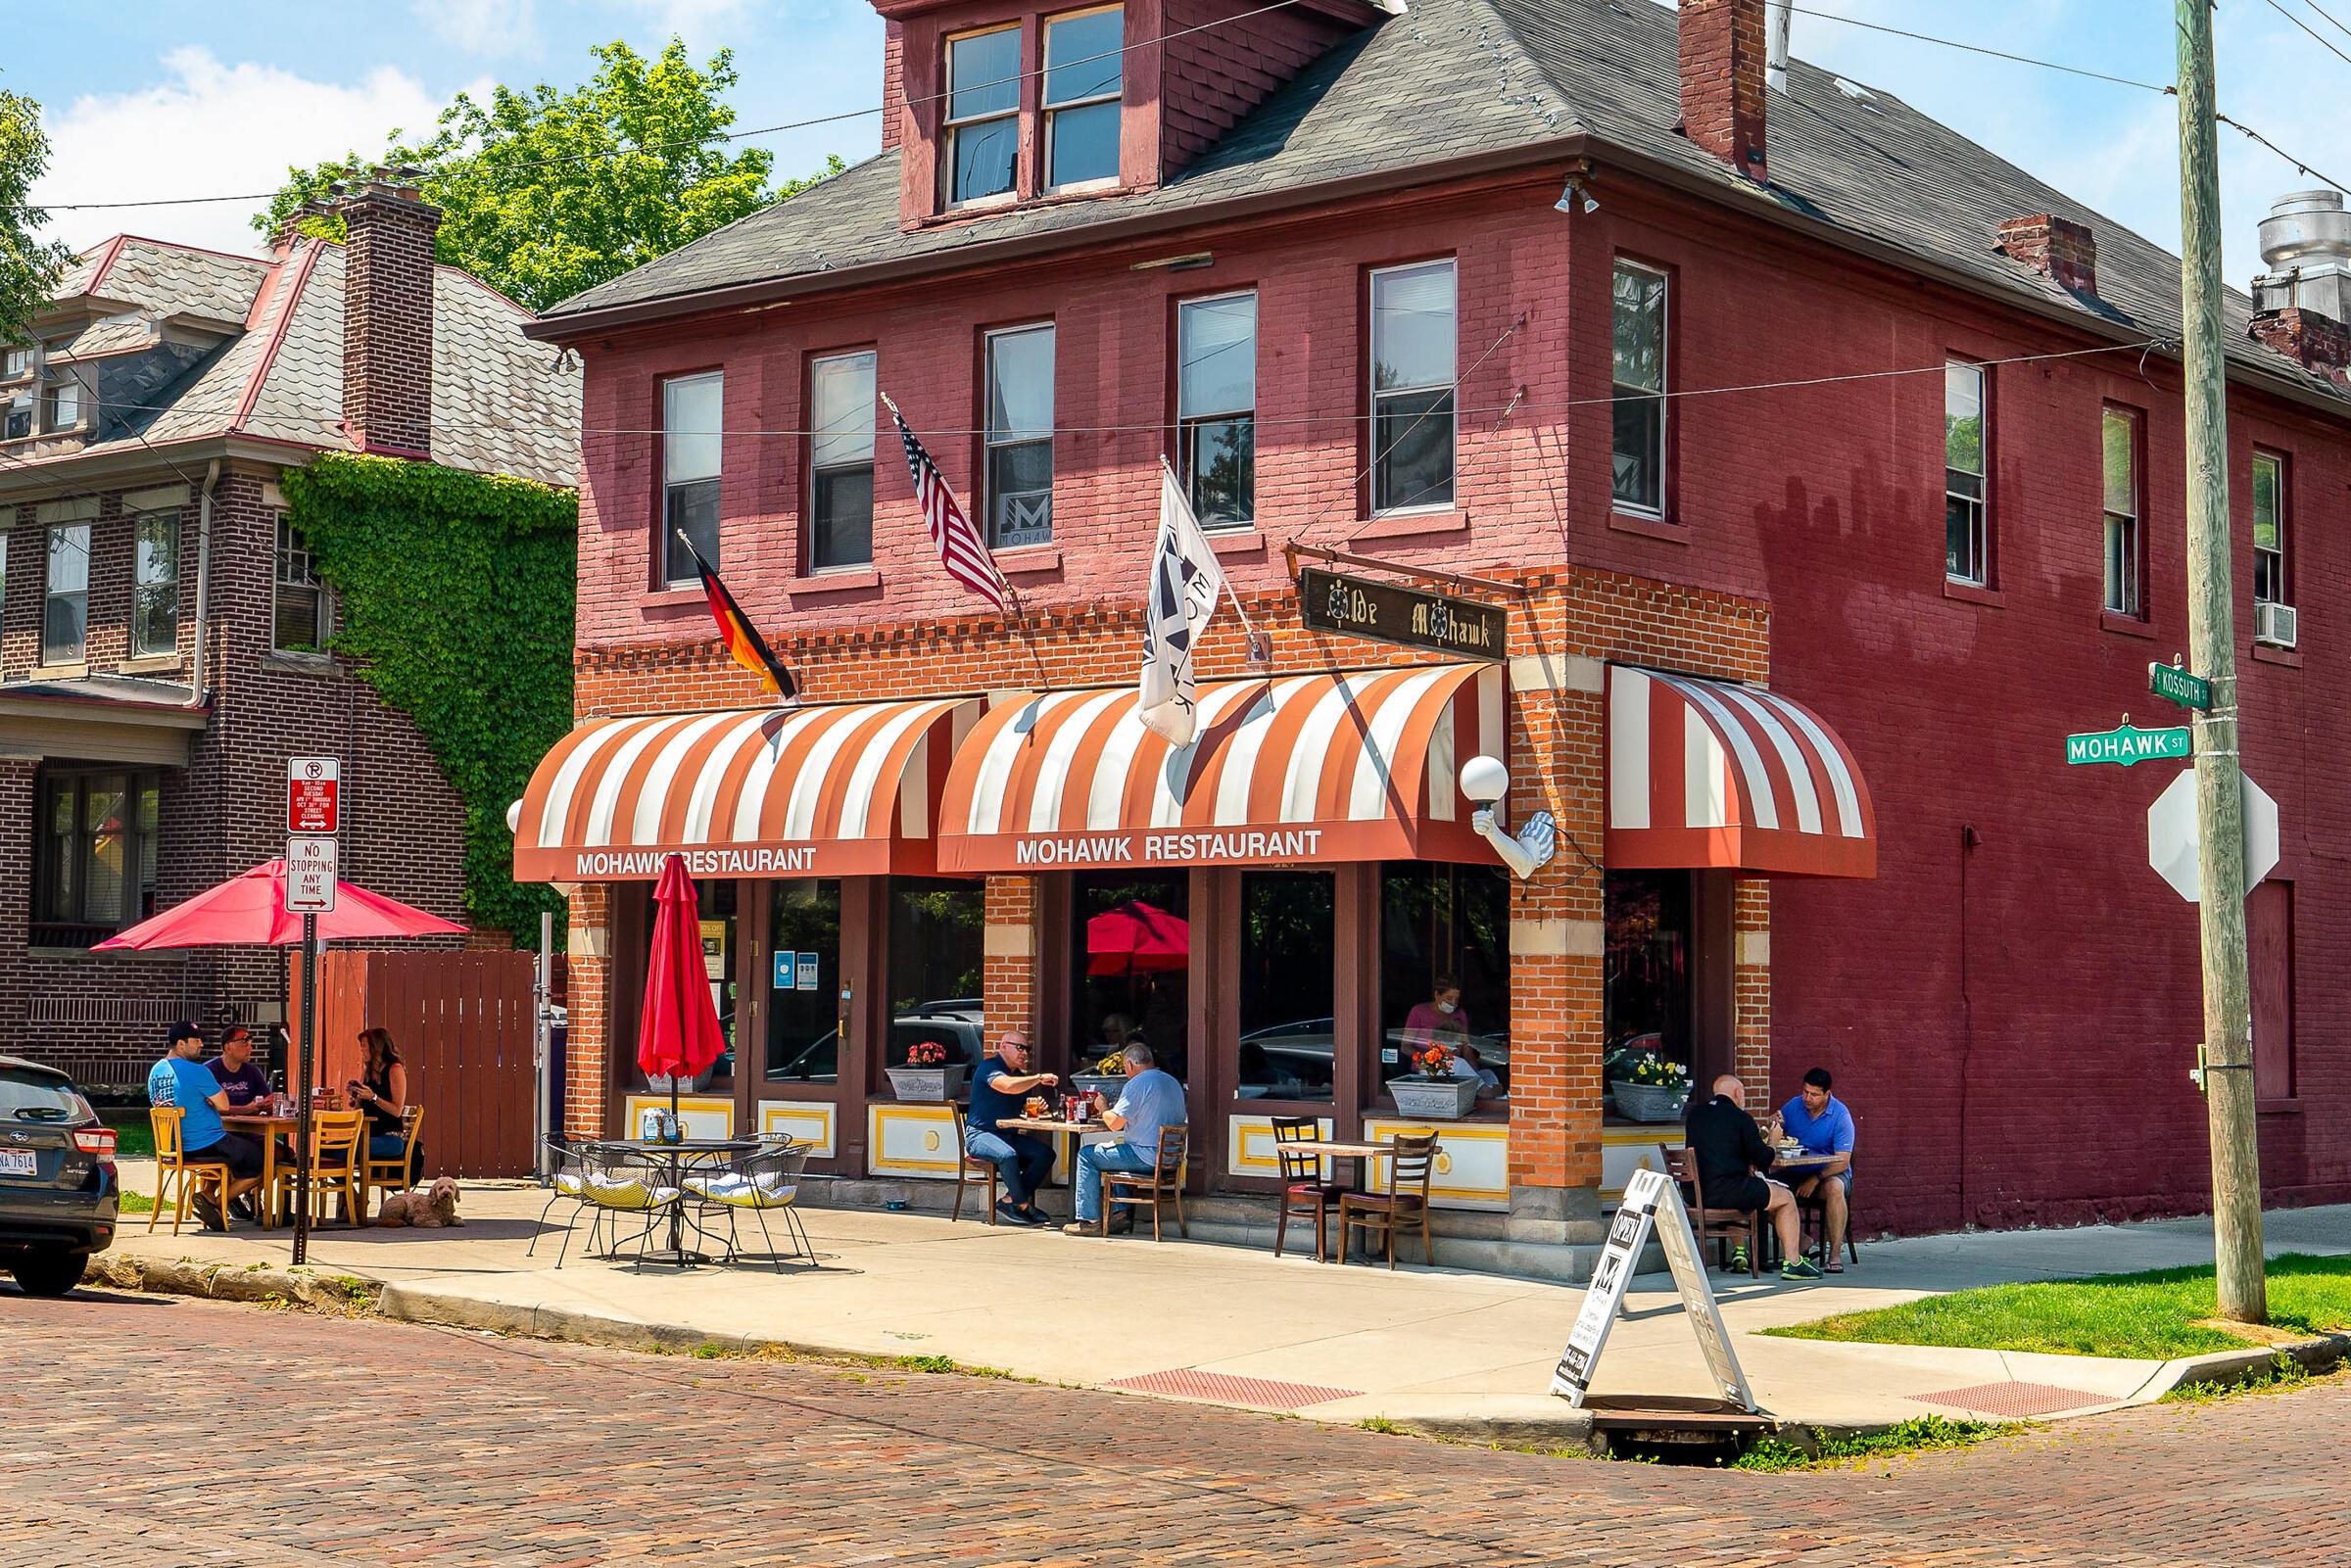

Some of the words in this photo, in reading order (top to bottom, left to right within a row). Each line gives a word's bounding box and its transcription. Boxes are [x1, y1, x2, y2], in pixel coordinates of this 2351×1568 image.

[999, 531, 1052, 546] MOHAW
[1412, 598, 1490, 647] Mohawk
[2162, 671, 2200, 702] KOSSUTH
[2071, 734, 2169, 760] MOHAWK
[2172, 736, 2184, 748] ST
[305, 845, 319, 857] NO
[1016, 835, 1132, 864] MOHAWK
[1145, 830, 1321, 862] RESTAURANT
[291, 860, 333, 873] STOPPING
[576, 851, 667, 876] MOHAWK
[682, 847, 816, 874] RESTAURANT
[303, 875, 321, 883] ANY
[301, 885, 321, 895] TIME
[12, 1155, 33, 1168] 7614
[1611, 1213, 1640, 1244] OPEN
